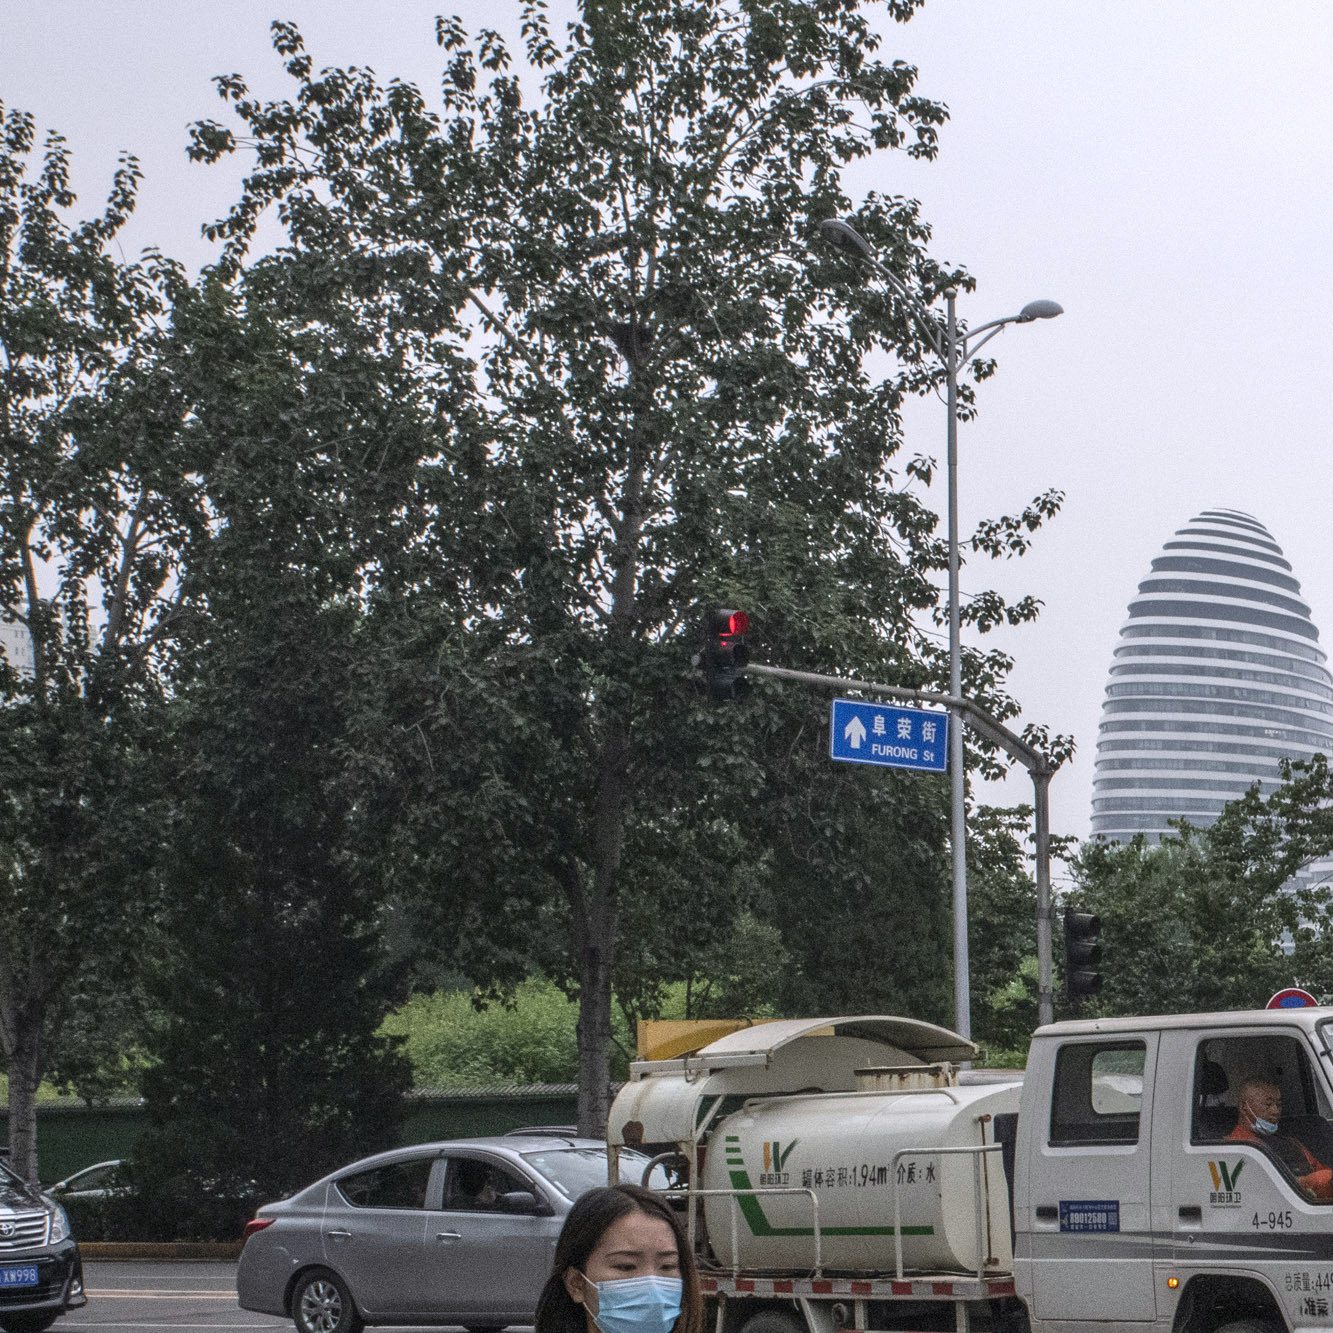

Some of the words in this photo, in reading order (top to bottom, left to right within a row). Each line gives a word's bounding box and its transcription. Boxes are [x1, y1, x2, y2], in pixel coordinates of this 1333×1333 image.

[872, 714, 936, 743] 阜荣街
[871, 743, 918, 760] FURONG
[923, 750, 935, 762] St
[1252, 1211, 1293, 1229] 4-945
